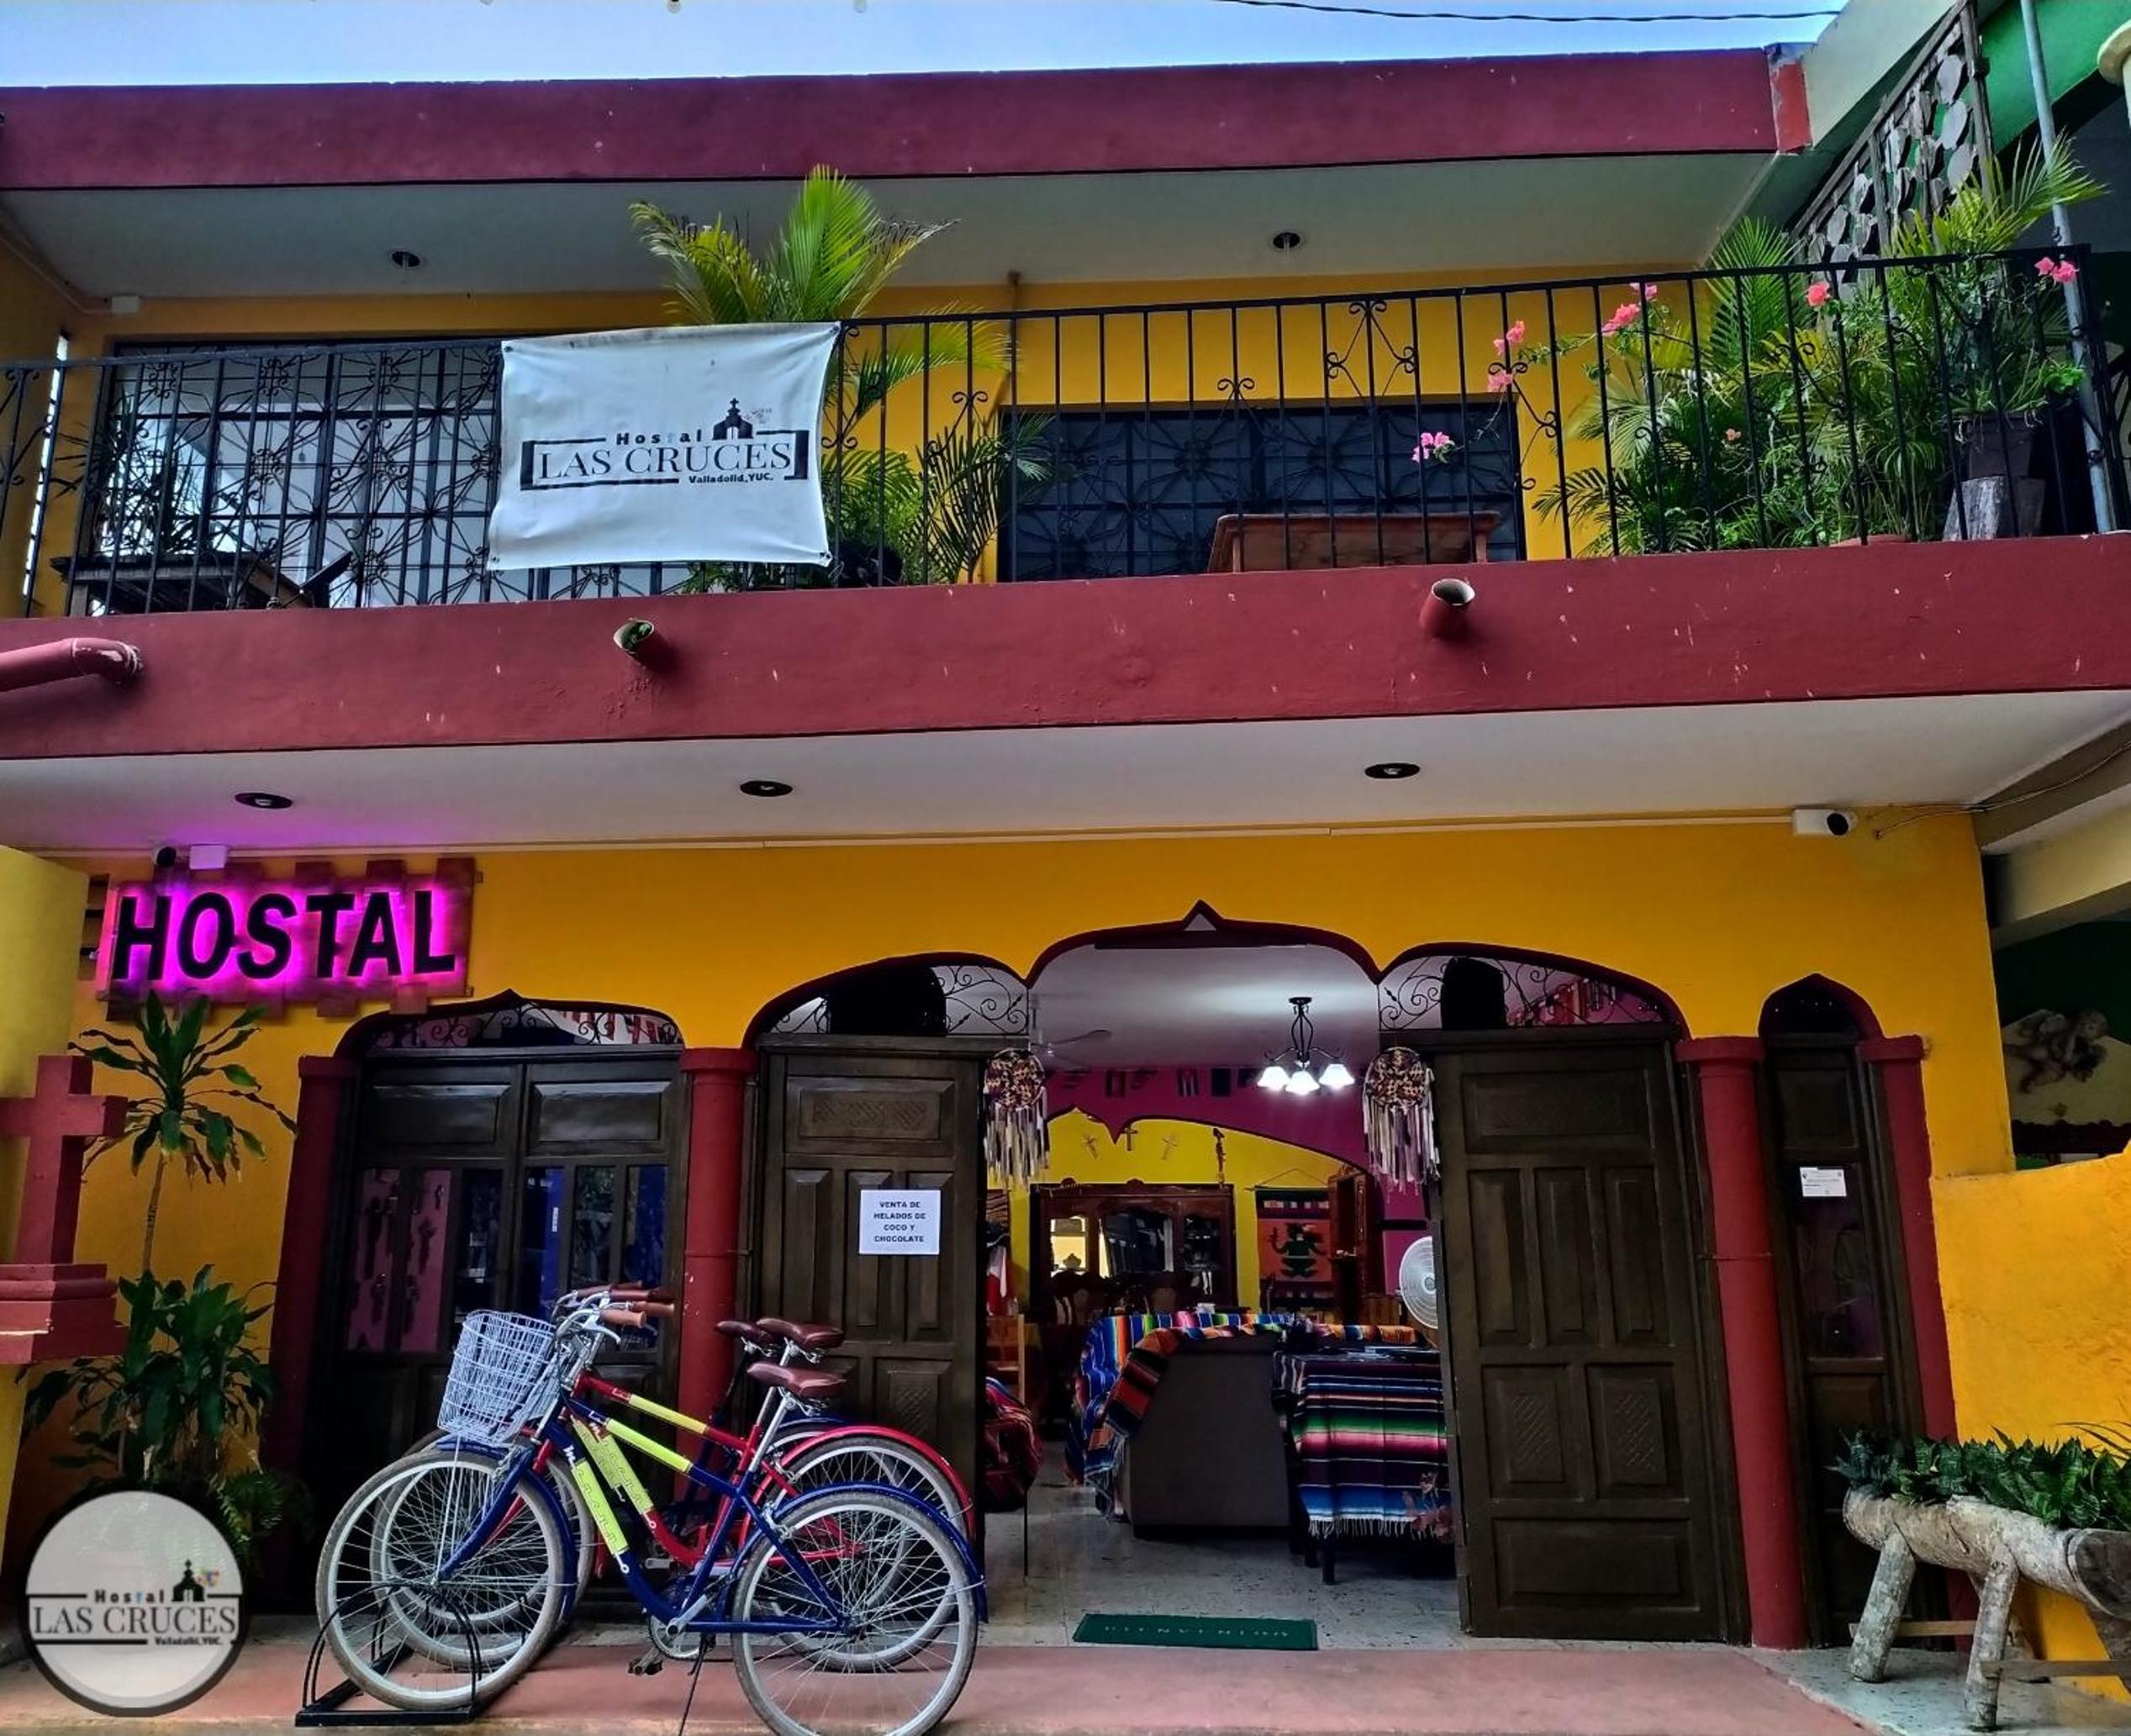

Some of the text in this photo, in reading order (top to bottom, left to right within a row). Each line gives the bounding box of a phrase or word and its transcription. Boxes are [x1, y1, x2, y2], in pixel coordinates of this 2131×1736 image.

[615, 428, 703, 446] Hostal
[539, 441, 792, 480] LAS CRUCES
[111, 889, 456, 981] HOSTAL
